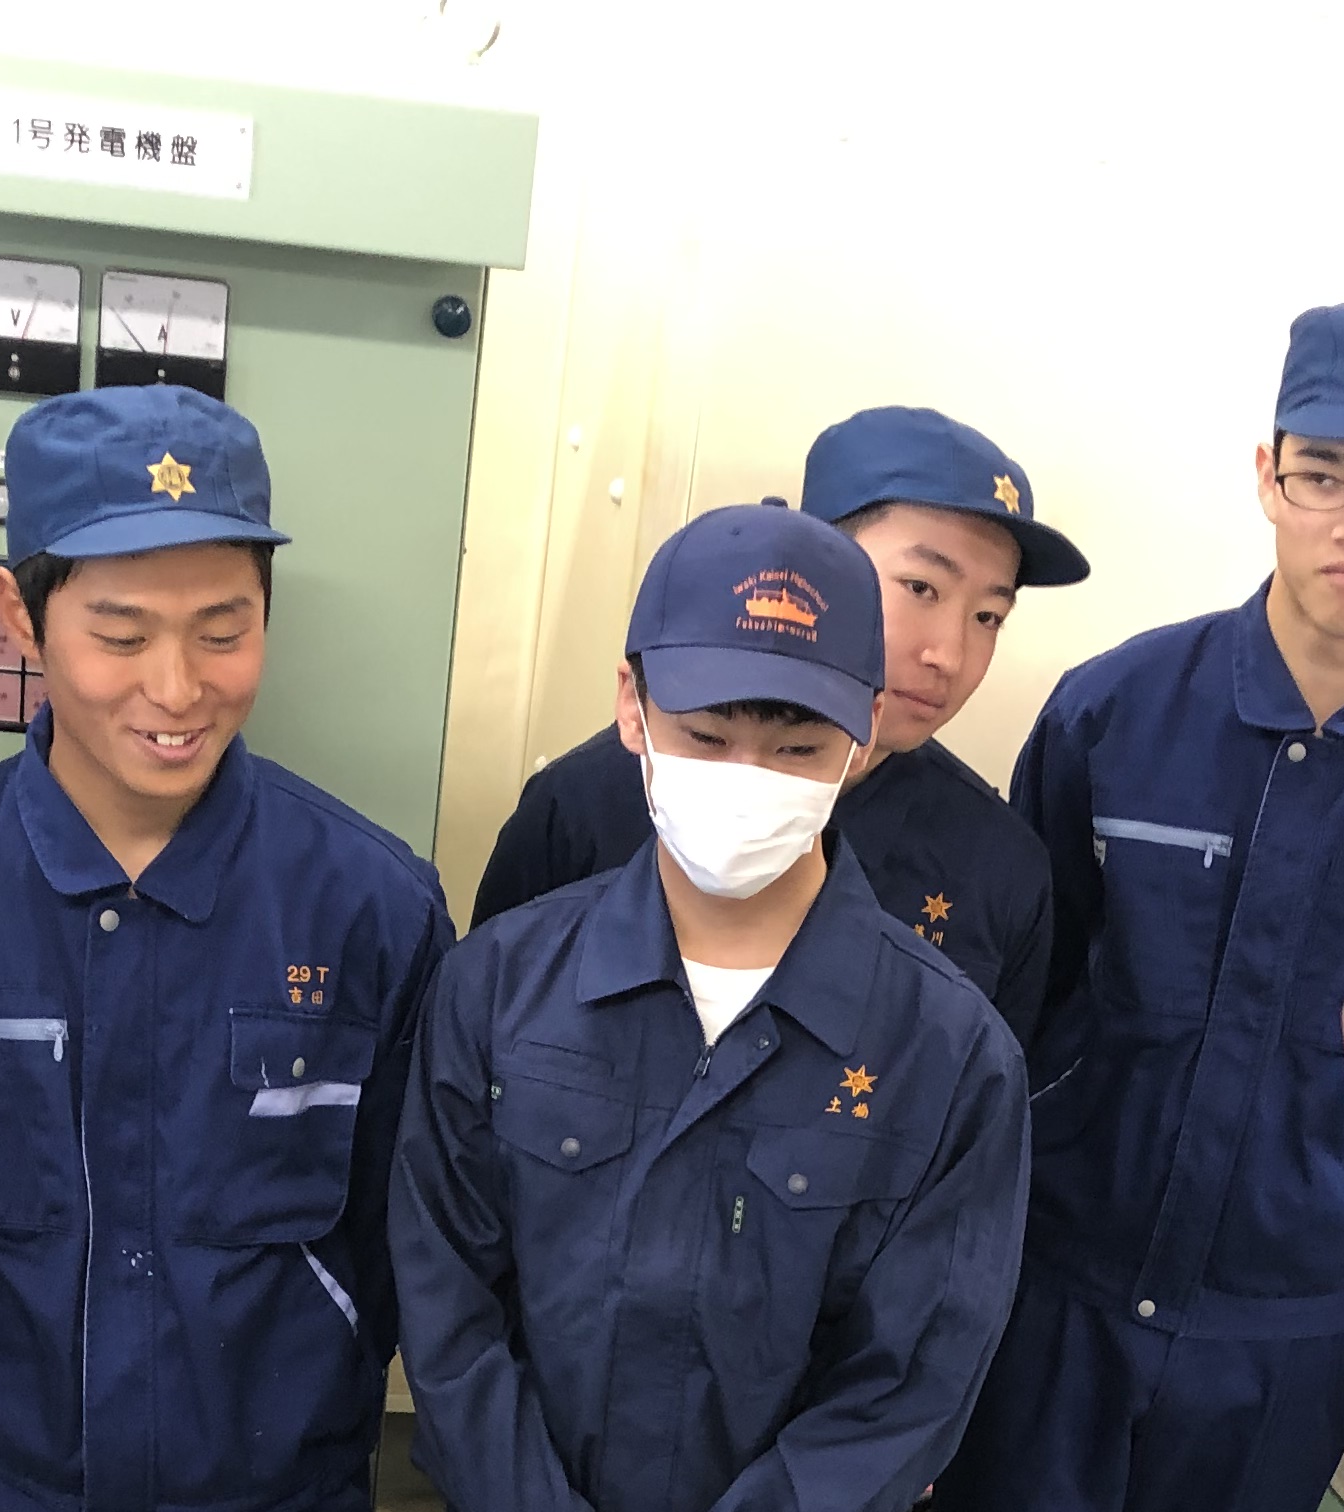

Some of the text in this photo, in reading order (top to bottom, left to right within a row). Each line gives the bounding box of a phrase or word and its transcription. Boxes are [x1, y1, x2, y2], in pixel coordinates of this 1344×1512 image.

[13, 117, 198, 167] 1号発電機盤
[10, 308, 21, 327] V
[157, 324, 168, 341] A
[286, 965, 330, 984] 29 T
